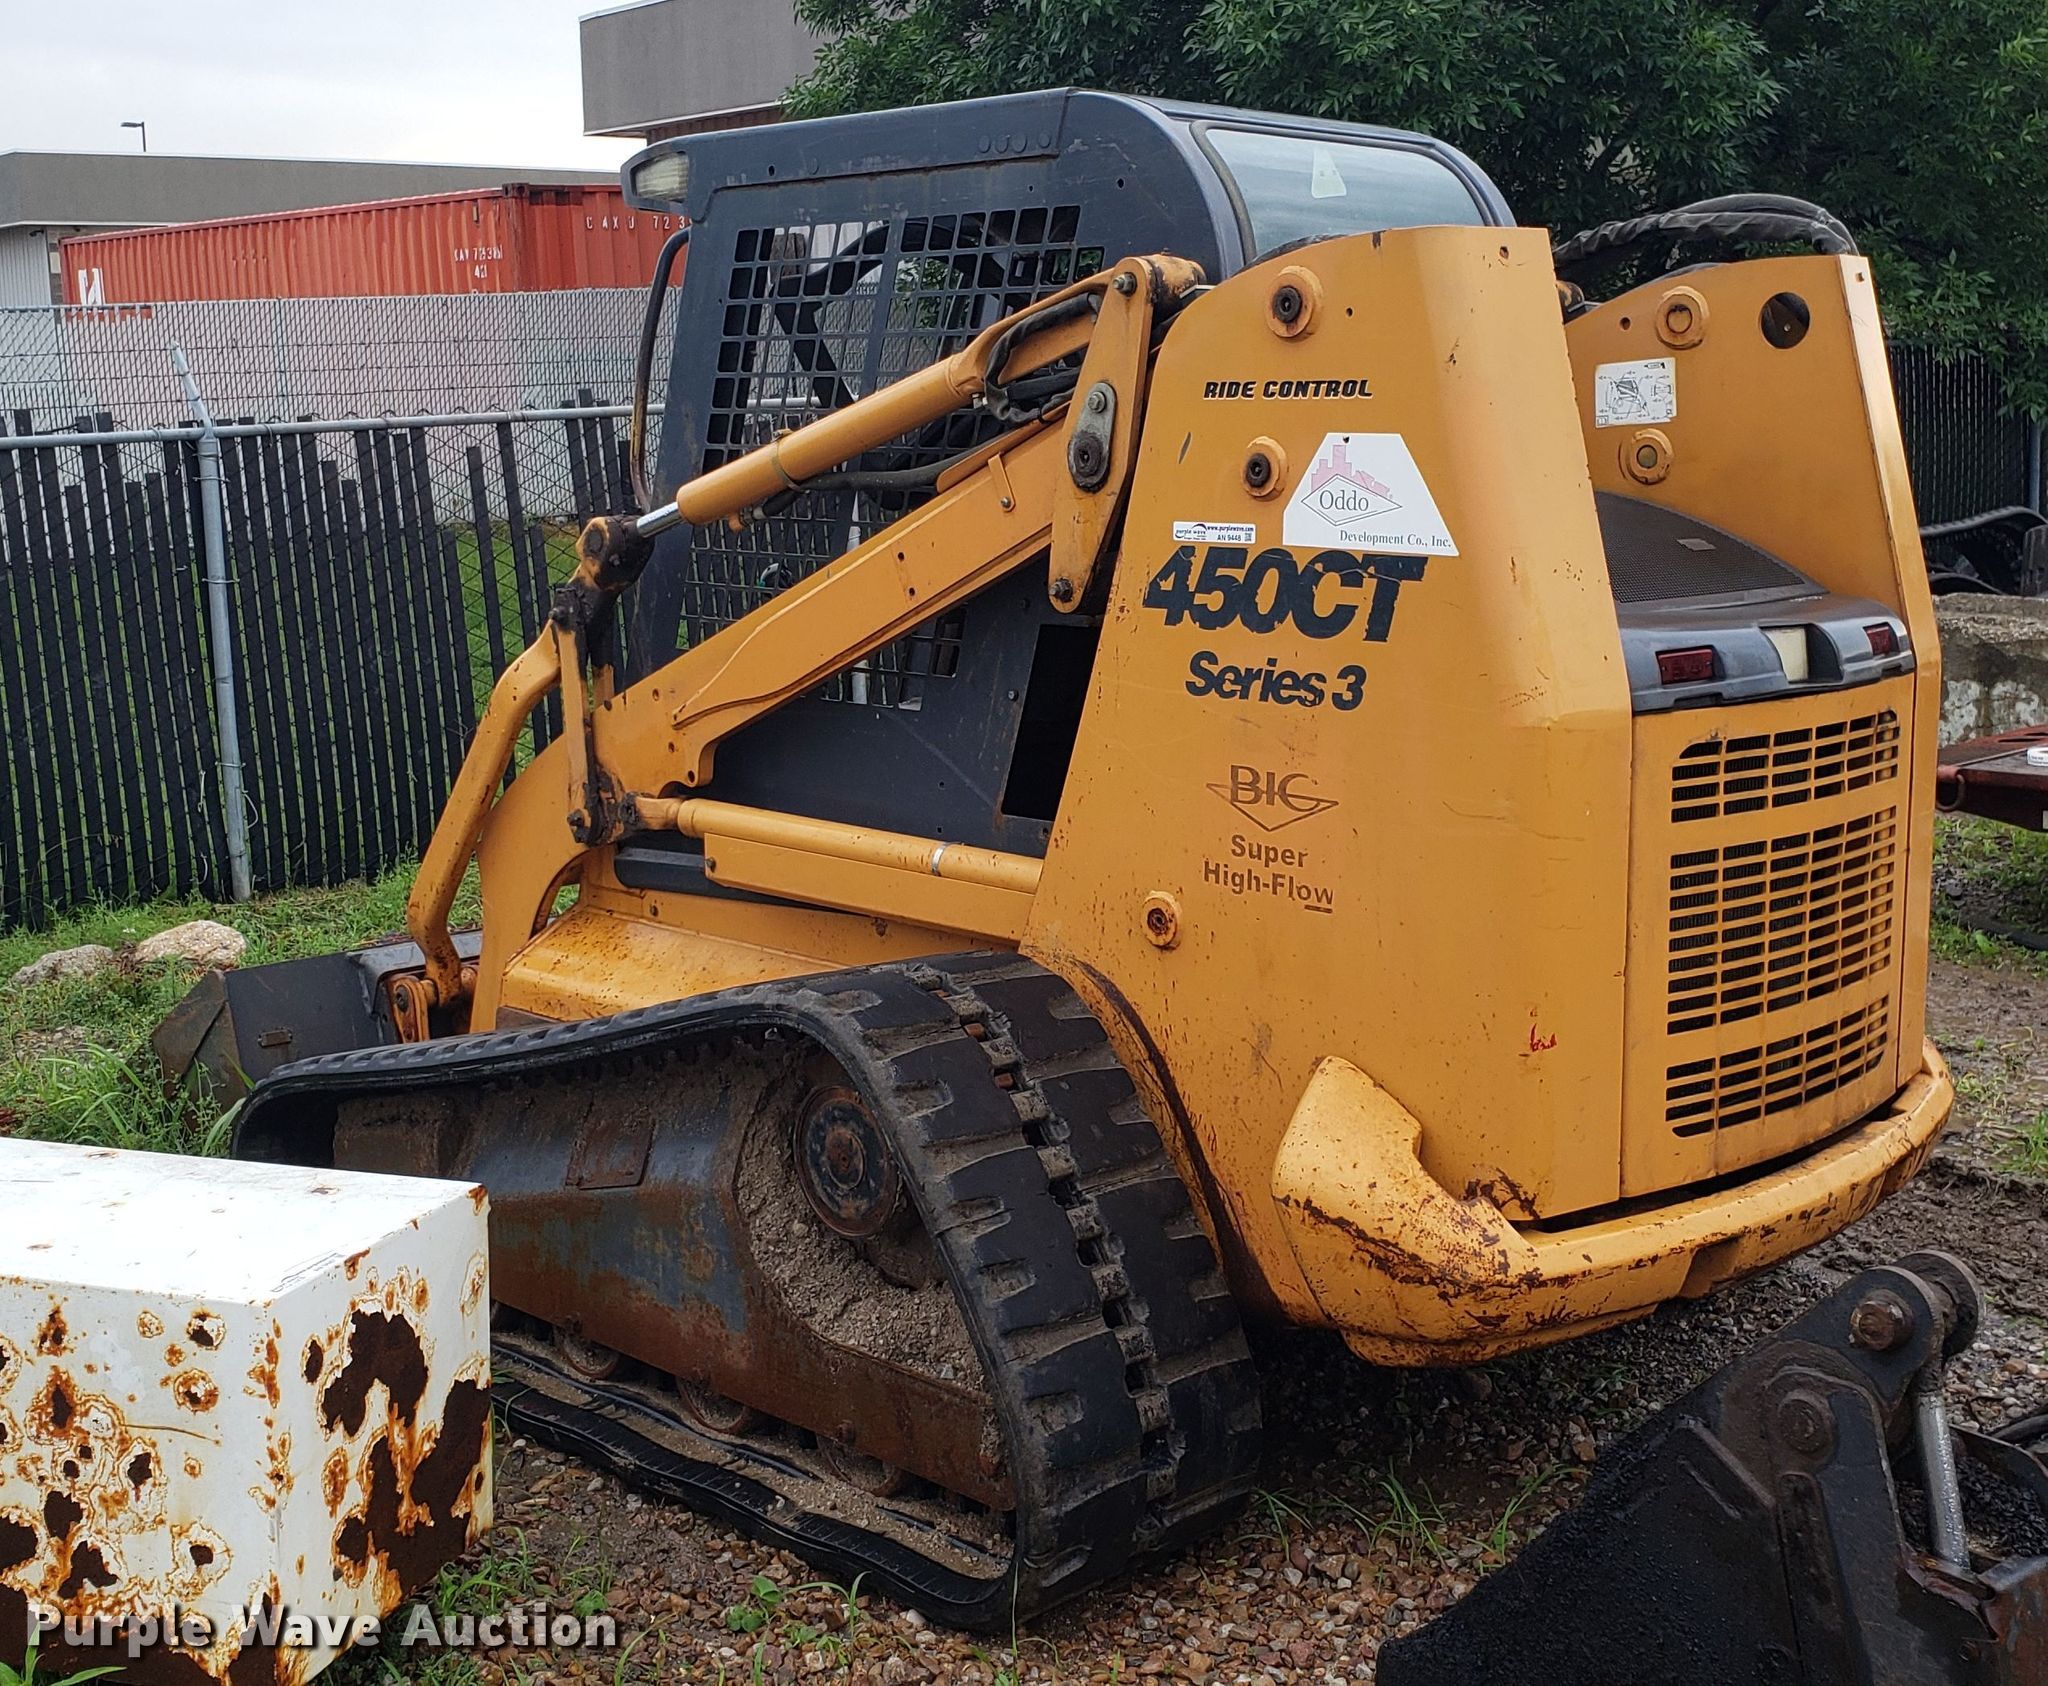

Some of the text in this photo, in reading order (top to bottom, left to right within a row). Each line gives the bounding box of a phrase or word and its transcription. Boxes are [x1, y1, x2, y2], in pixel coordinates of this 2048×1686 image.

[1203, 379, 1373, 399] RIDE CONTROL
[1319, 489, 1369, 511] Oddo
[1340, 530, 1451, 547] Development Co., Inc.
[1143, 545, 1429, 642] 450CT
[1186, 651, 1367, 710] Series 3
[1231, 834, 1308, 868] Super
[1204, 859, 1334, 905] High-Flow
